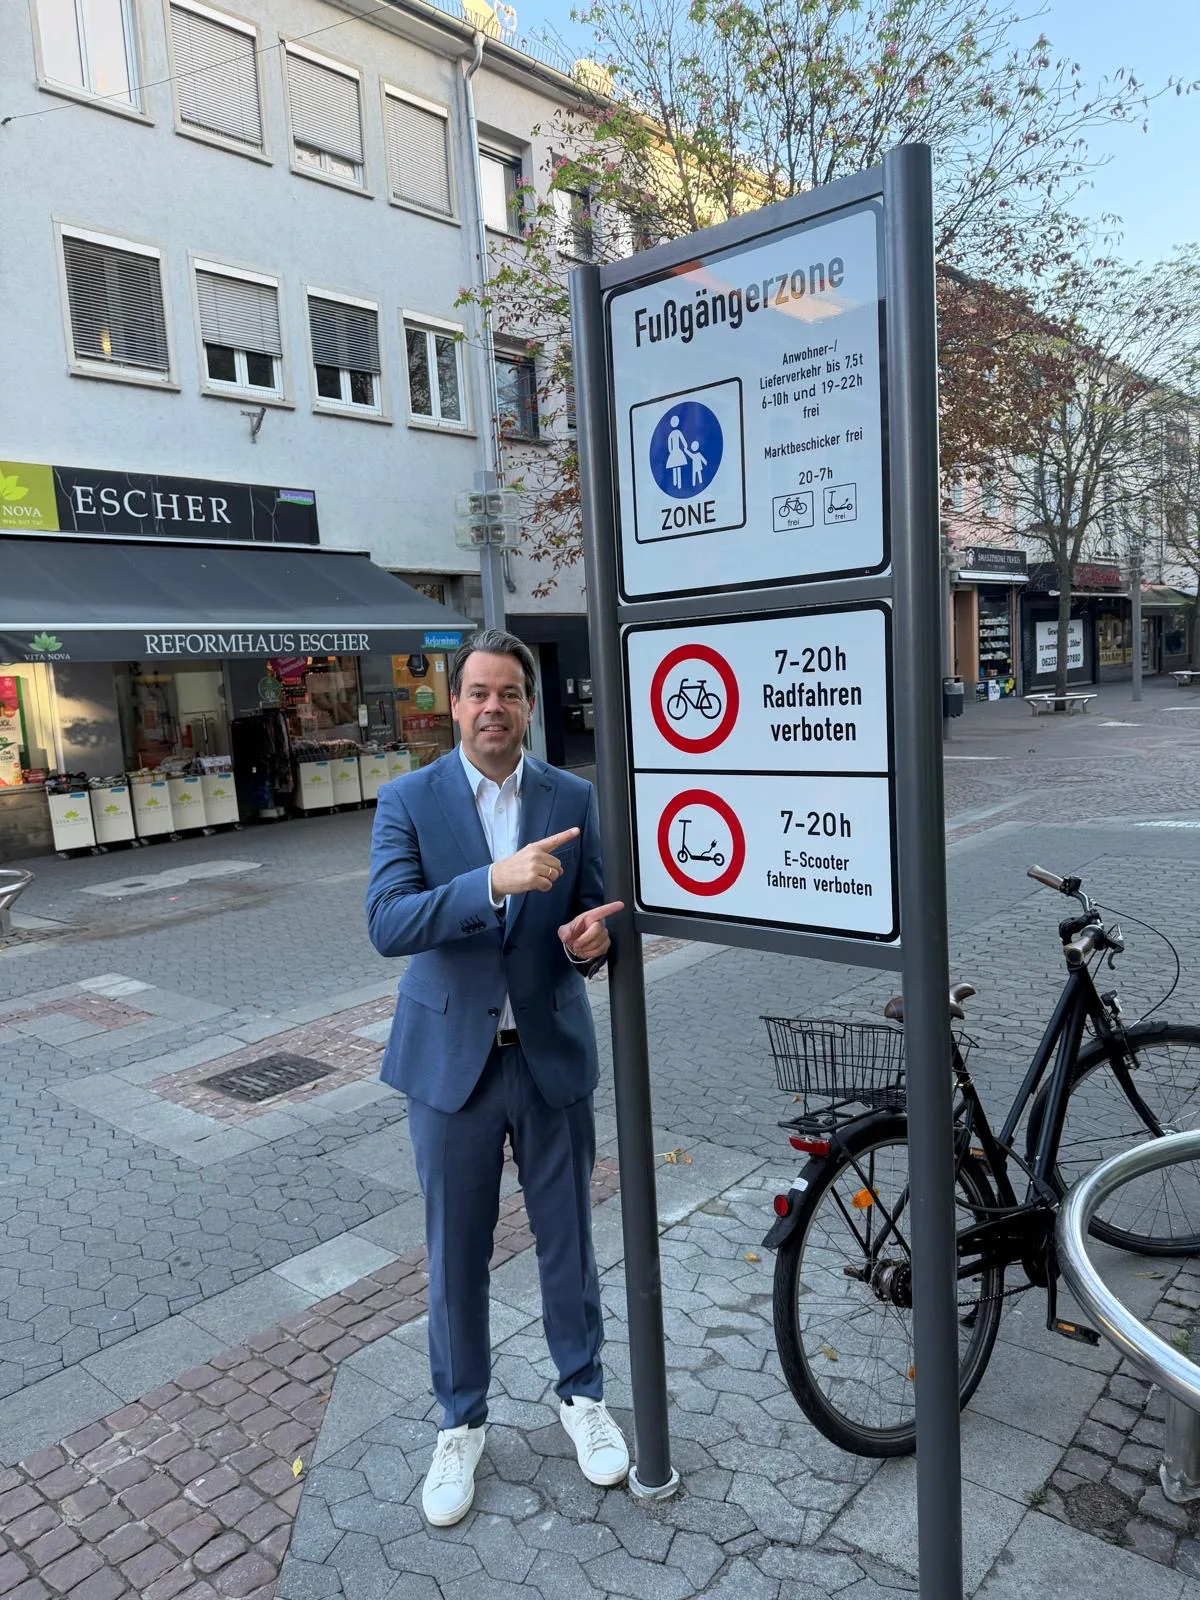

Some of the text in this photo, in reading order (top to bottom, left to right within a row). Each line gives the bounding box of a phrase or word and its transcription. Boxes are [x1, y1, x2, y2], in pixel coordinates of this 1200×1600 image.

[635, 257, 844, 347] Fußgängerzone
[782, 339, 838, 365] Anwohner-/
[760, 364, 822, 389] Lieferverkehr
[826, 360, 840, 373] bis
[762, 374, 863, 409] 6-10h und 19-22h
[803, 403, 819, 419] frei
[764, 427, 863, 459] Marktbeschicker frei
[799, 467, 833, 485] 20-7h
[2, 505, 42, 517] NOVA
[72, 485, 232, 523] ESCHER
[661, 500, 716, 530] ZONE
[787, 519, 800, 527] frei
[144, 633, 370, 654] REFORMHAUS ESCHER
[775, 646, 846, 674] 7-20h
[763, 682, 862, 708] Radfahren
[771, 716, 857, 741] verboten
[781, 811, 851, 837] 7-20h
[784, 850, 849, 871] E-Scooter
[767, 870, 872, 896] fahren verboten
